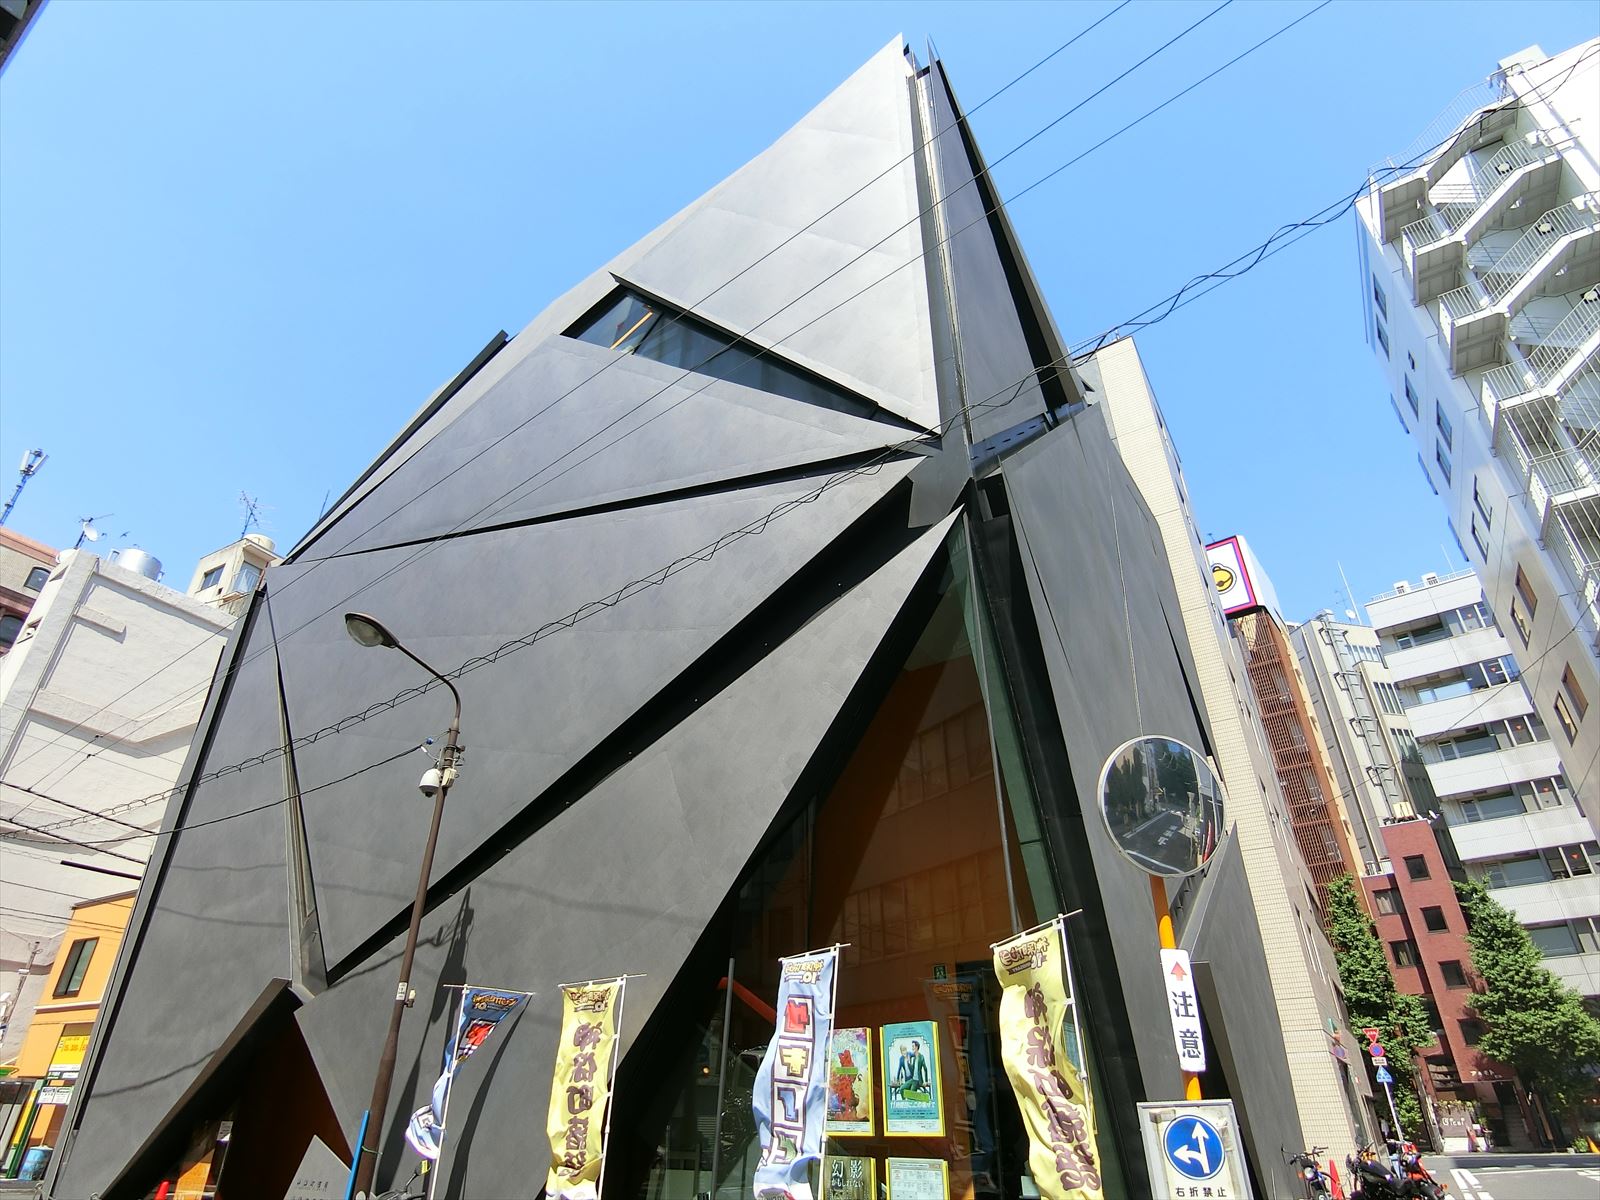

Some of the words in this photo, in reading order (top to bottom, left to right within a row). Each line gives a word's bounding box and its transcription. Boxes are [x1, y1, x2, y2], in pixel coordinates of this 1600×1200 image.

[1171, 990, 1202, 1059] 注意
[831, 1159, 863, 1178] 幻影
[1175, 1186, 1227, 1198] 右折禁止
